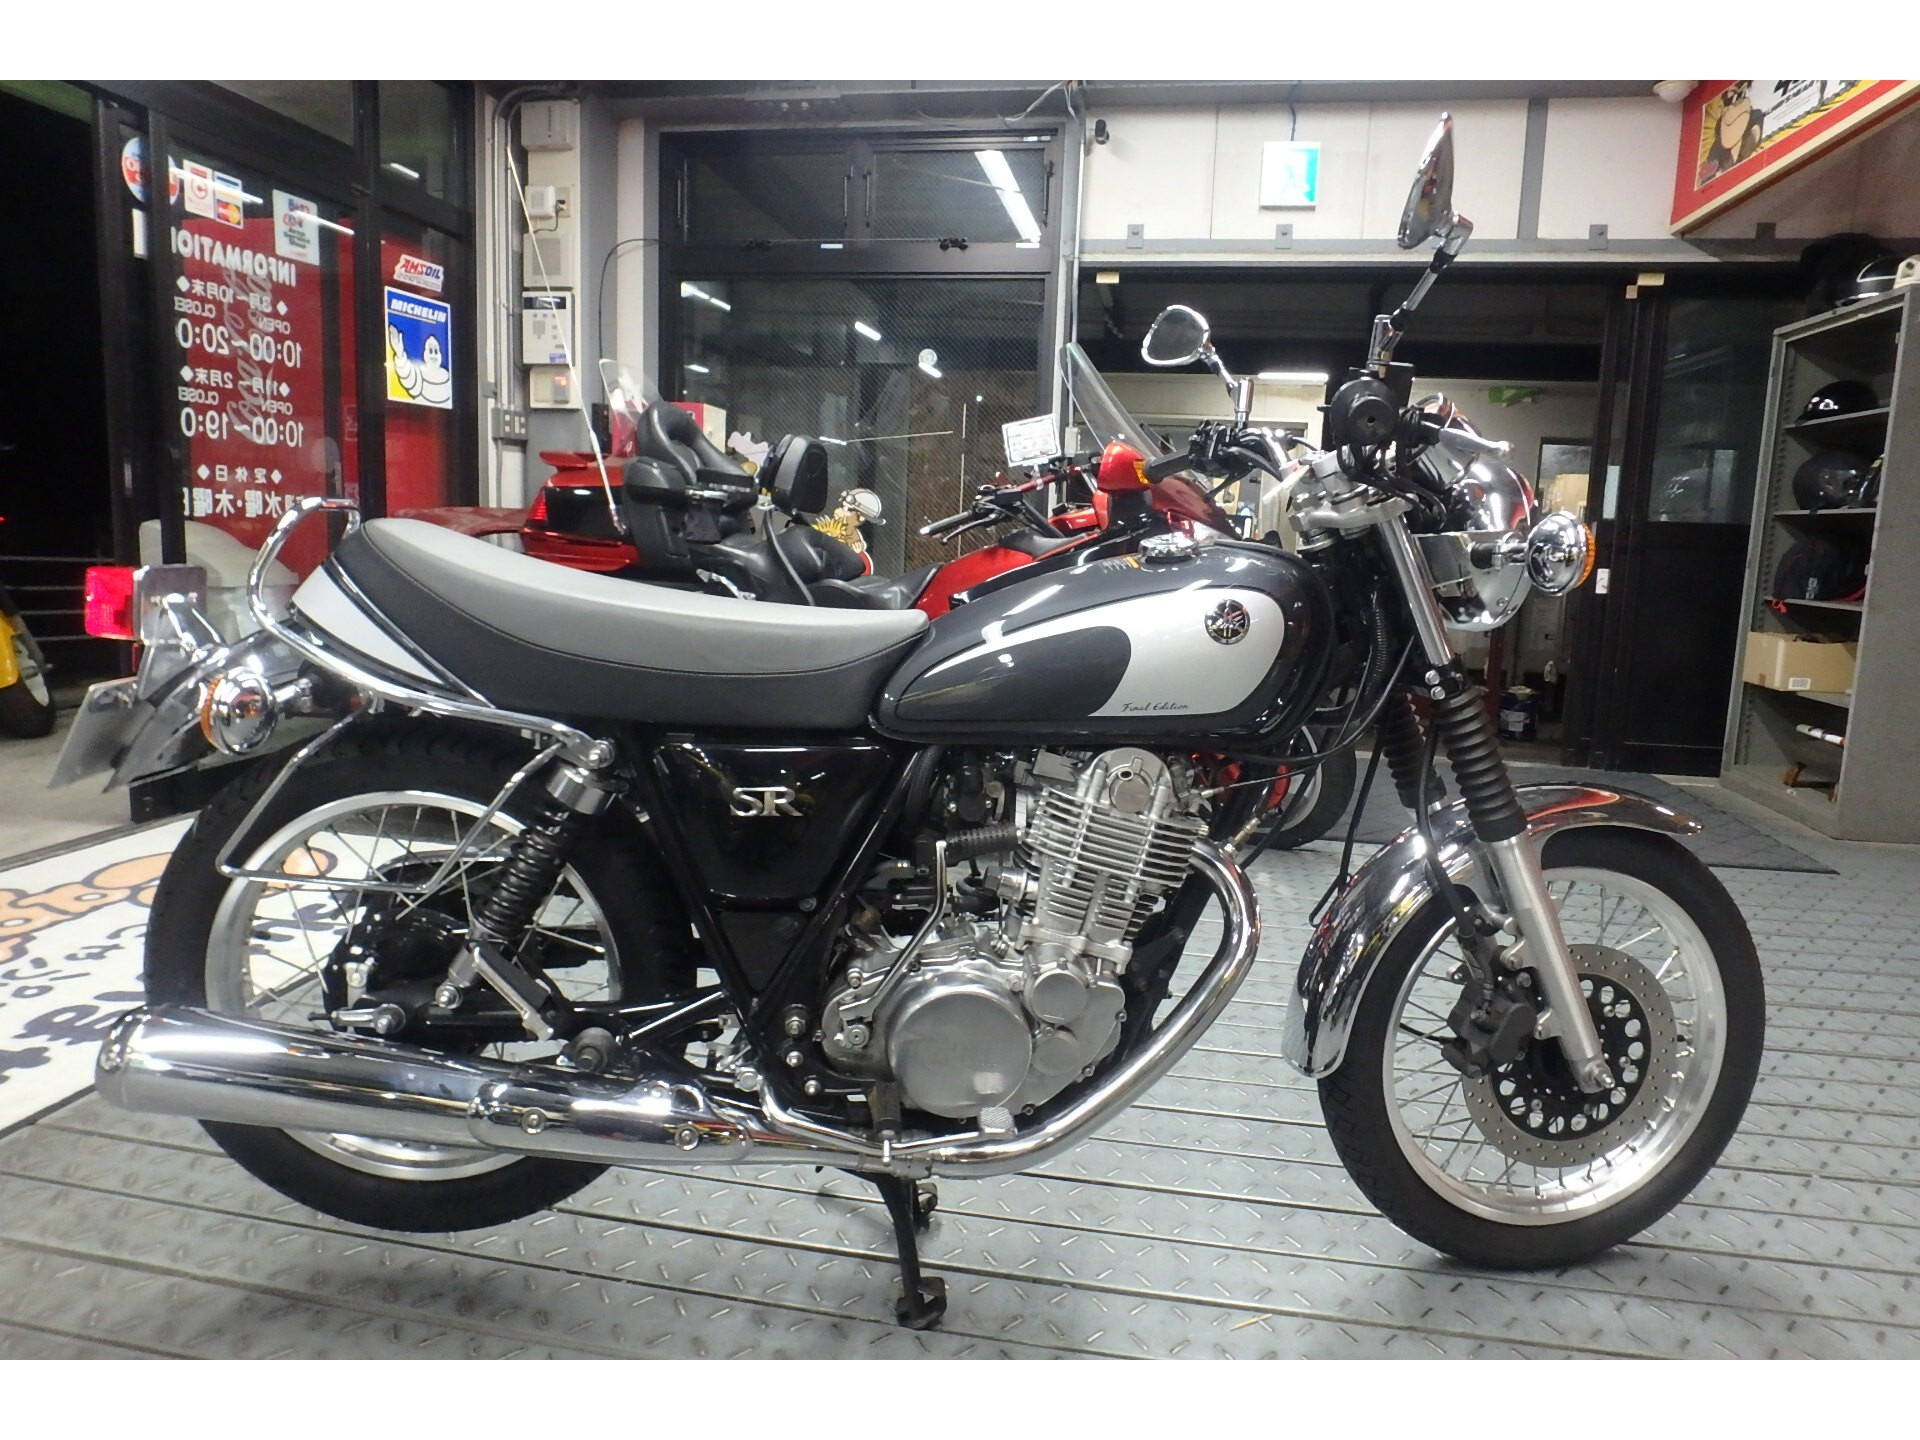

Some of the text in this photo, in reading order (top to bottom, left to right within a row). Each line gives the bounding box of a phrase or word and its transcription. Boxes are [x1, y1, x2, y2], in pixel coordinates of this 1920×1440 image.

[400, 258, 441, 280] AMSOIL
[391, 298, 447, 323] MICHELIN
[1121, 702, 1189, 713] Final Edition
[729, 786, 804, 817] SR
